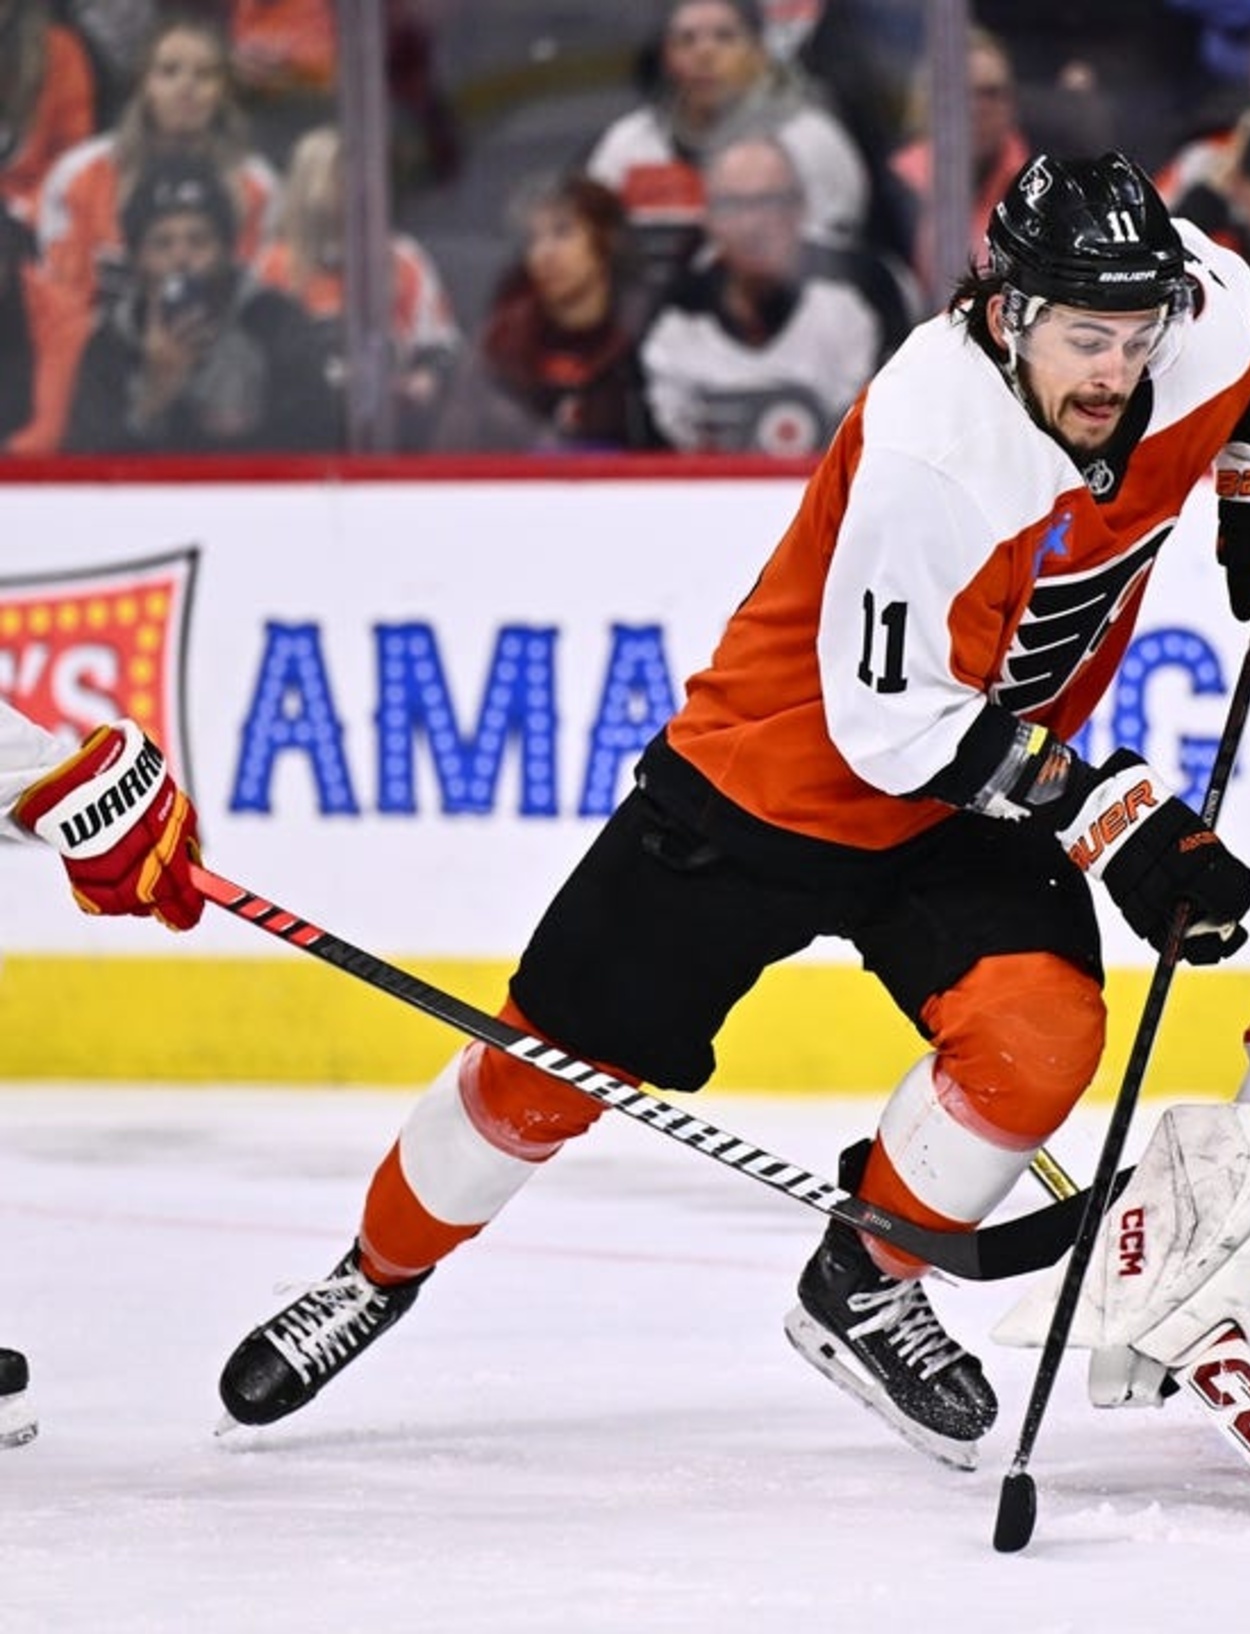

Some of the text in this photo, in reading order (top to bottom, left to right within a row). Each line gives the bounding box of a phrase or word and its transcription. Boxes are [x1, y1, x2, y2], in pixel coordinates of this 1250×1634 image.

[1106, 210, 1140, 243] 11
[857, 588, 908, 694] 11
[504, 1034, 853, 1215] WARRIOR
[1117, 1206, 1147, 1278] CCM
